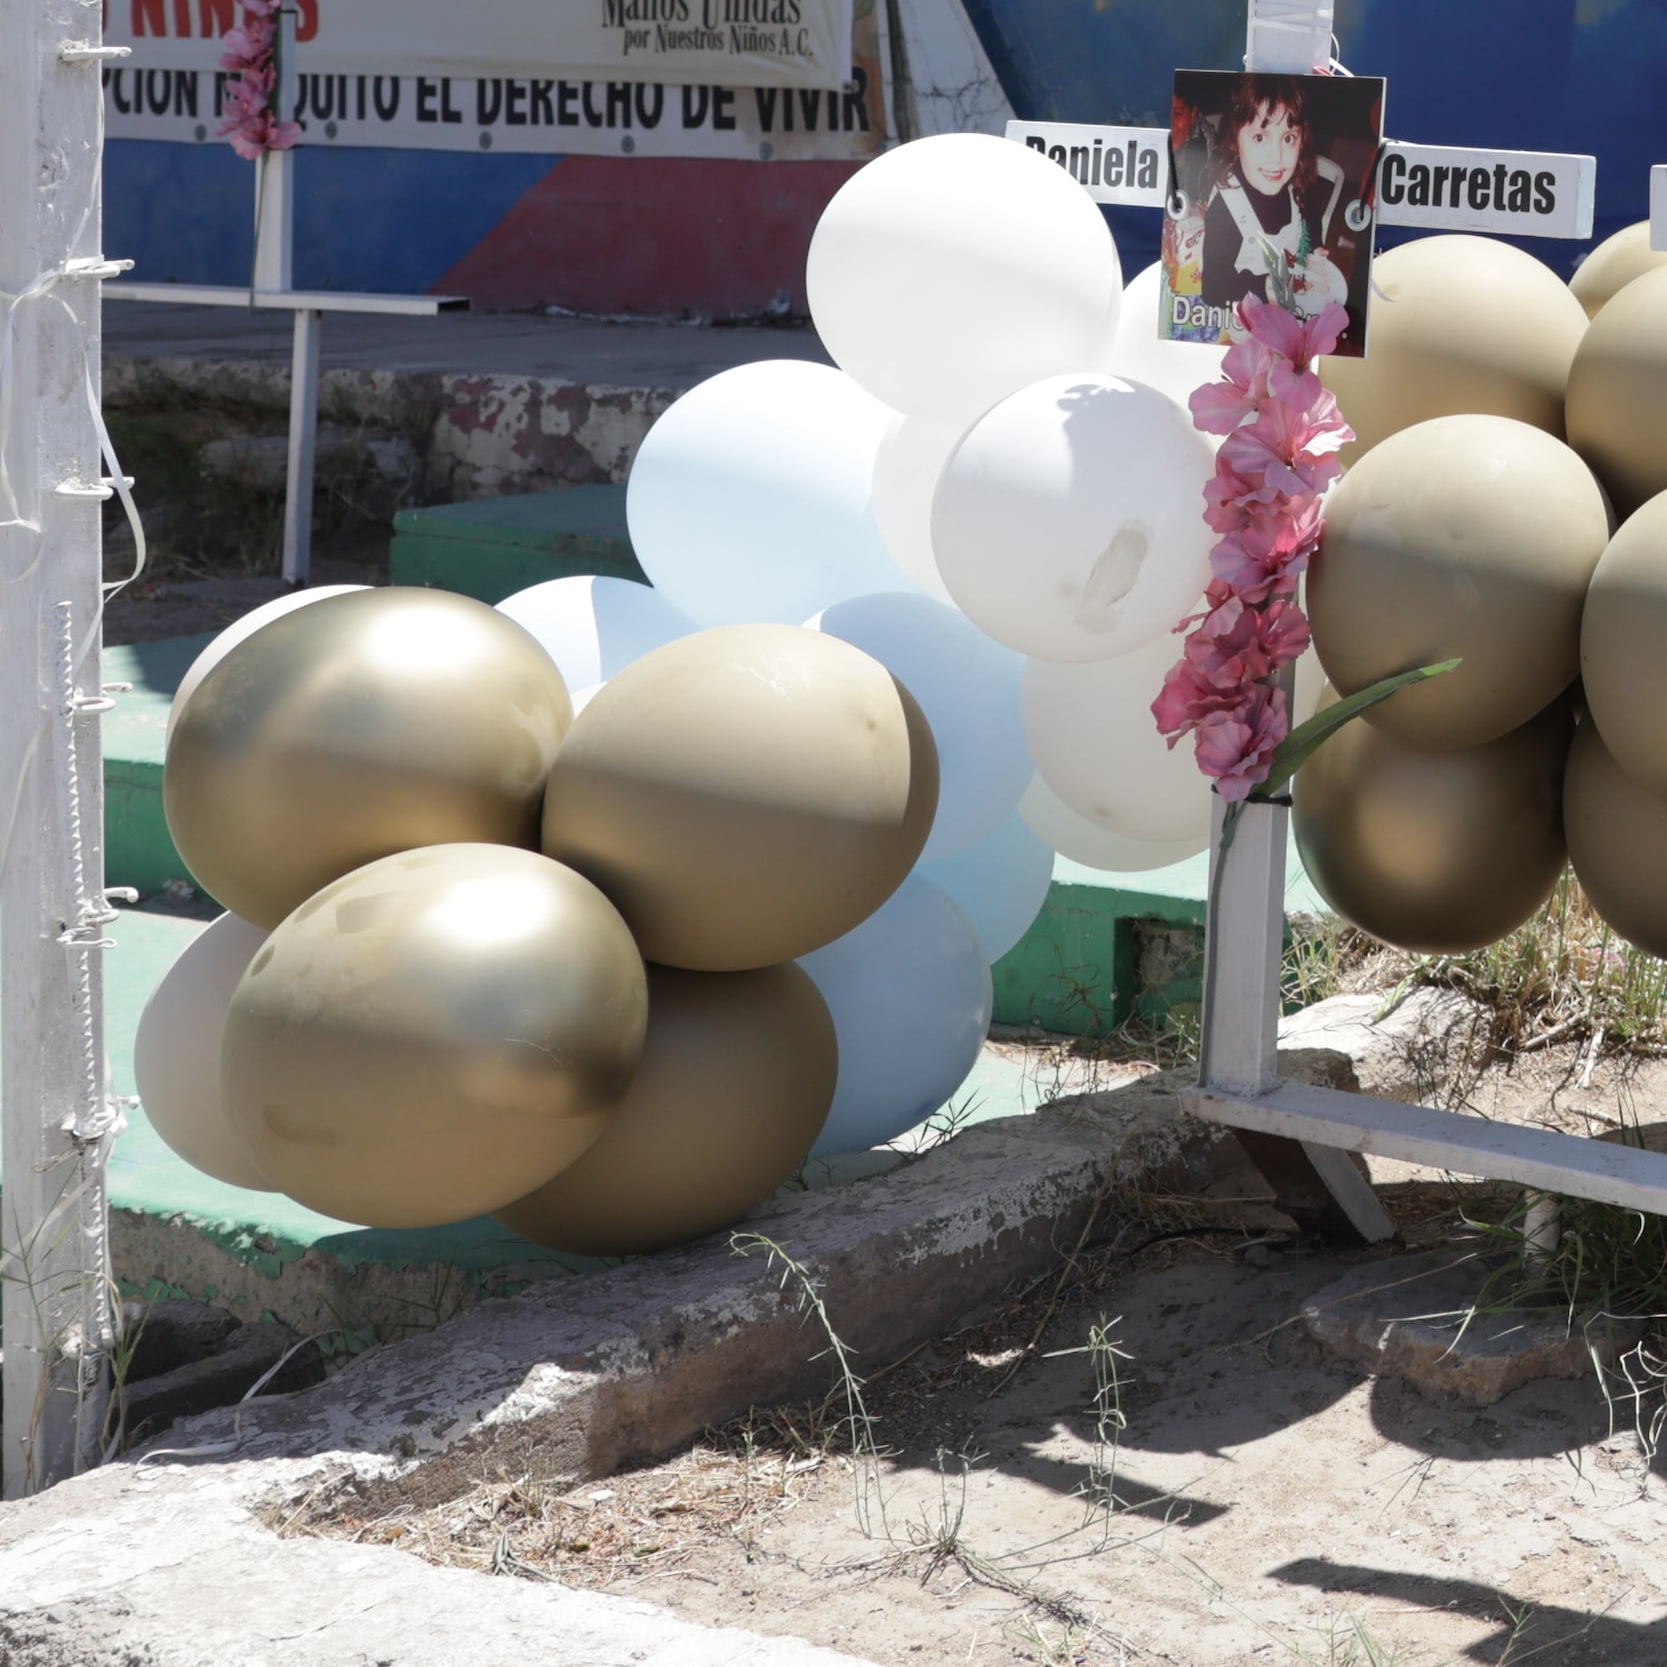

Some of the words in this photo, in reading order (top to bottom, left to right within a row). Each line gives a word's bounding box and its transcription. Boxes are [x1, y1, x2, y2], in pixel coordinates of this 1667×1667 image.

[623, 28, 651, 56] por
[654, 24, 724, 53] Nuestros
[729, 24, 776, 54] Niños
[777, 29, 814, 57] A.C.
[416, 77, 462, 124] EL
[477, 78, 664, 130] DERECHO
[681, 84, 736, 131] DE
[753, 66, 871, 133] VIVIR
[1381, 153, 1557, 215] Carretas
